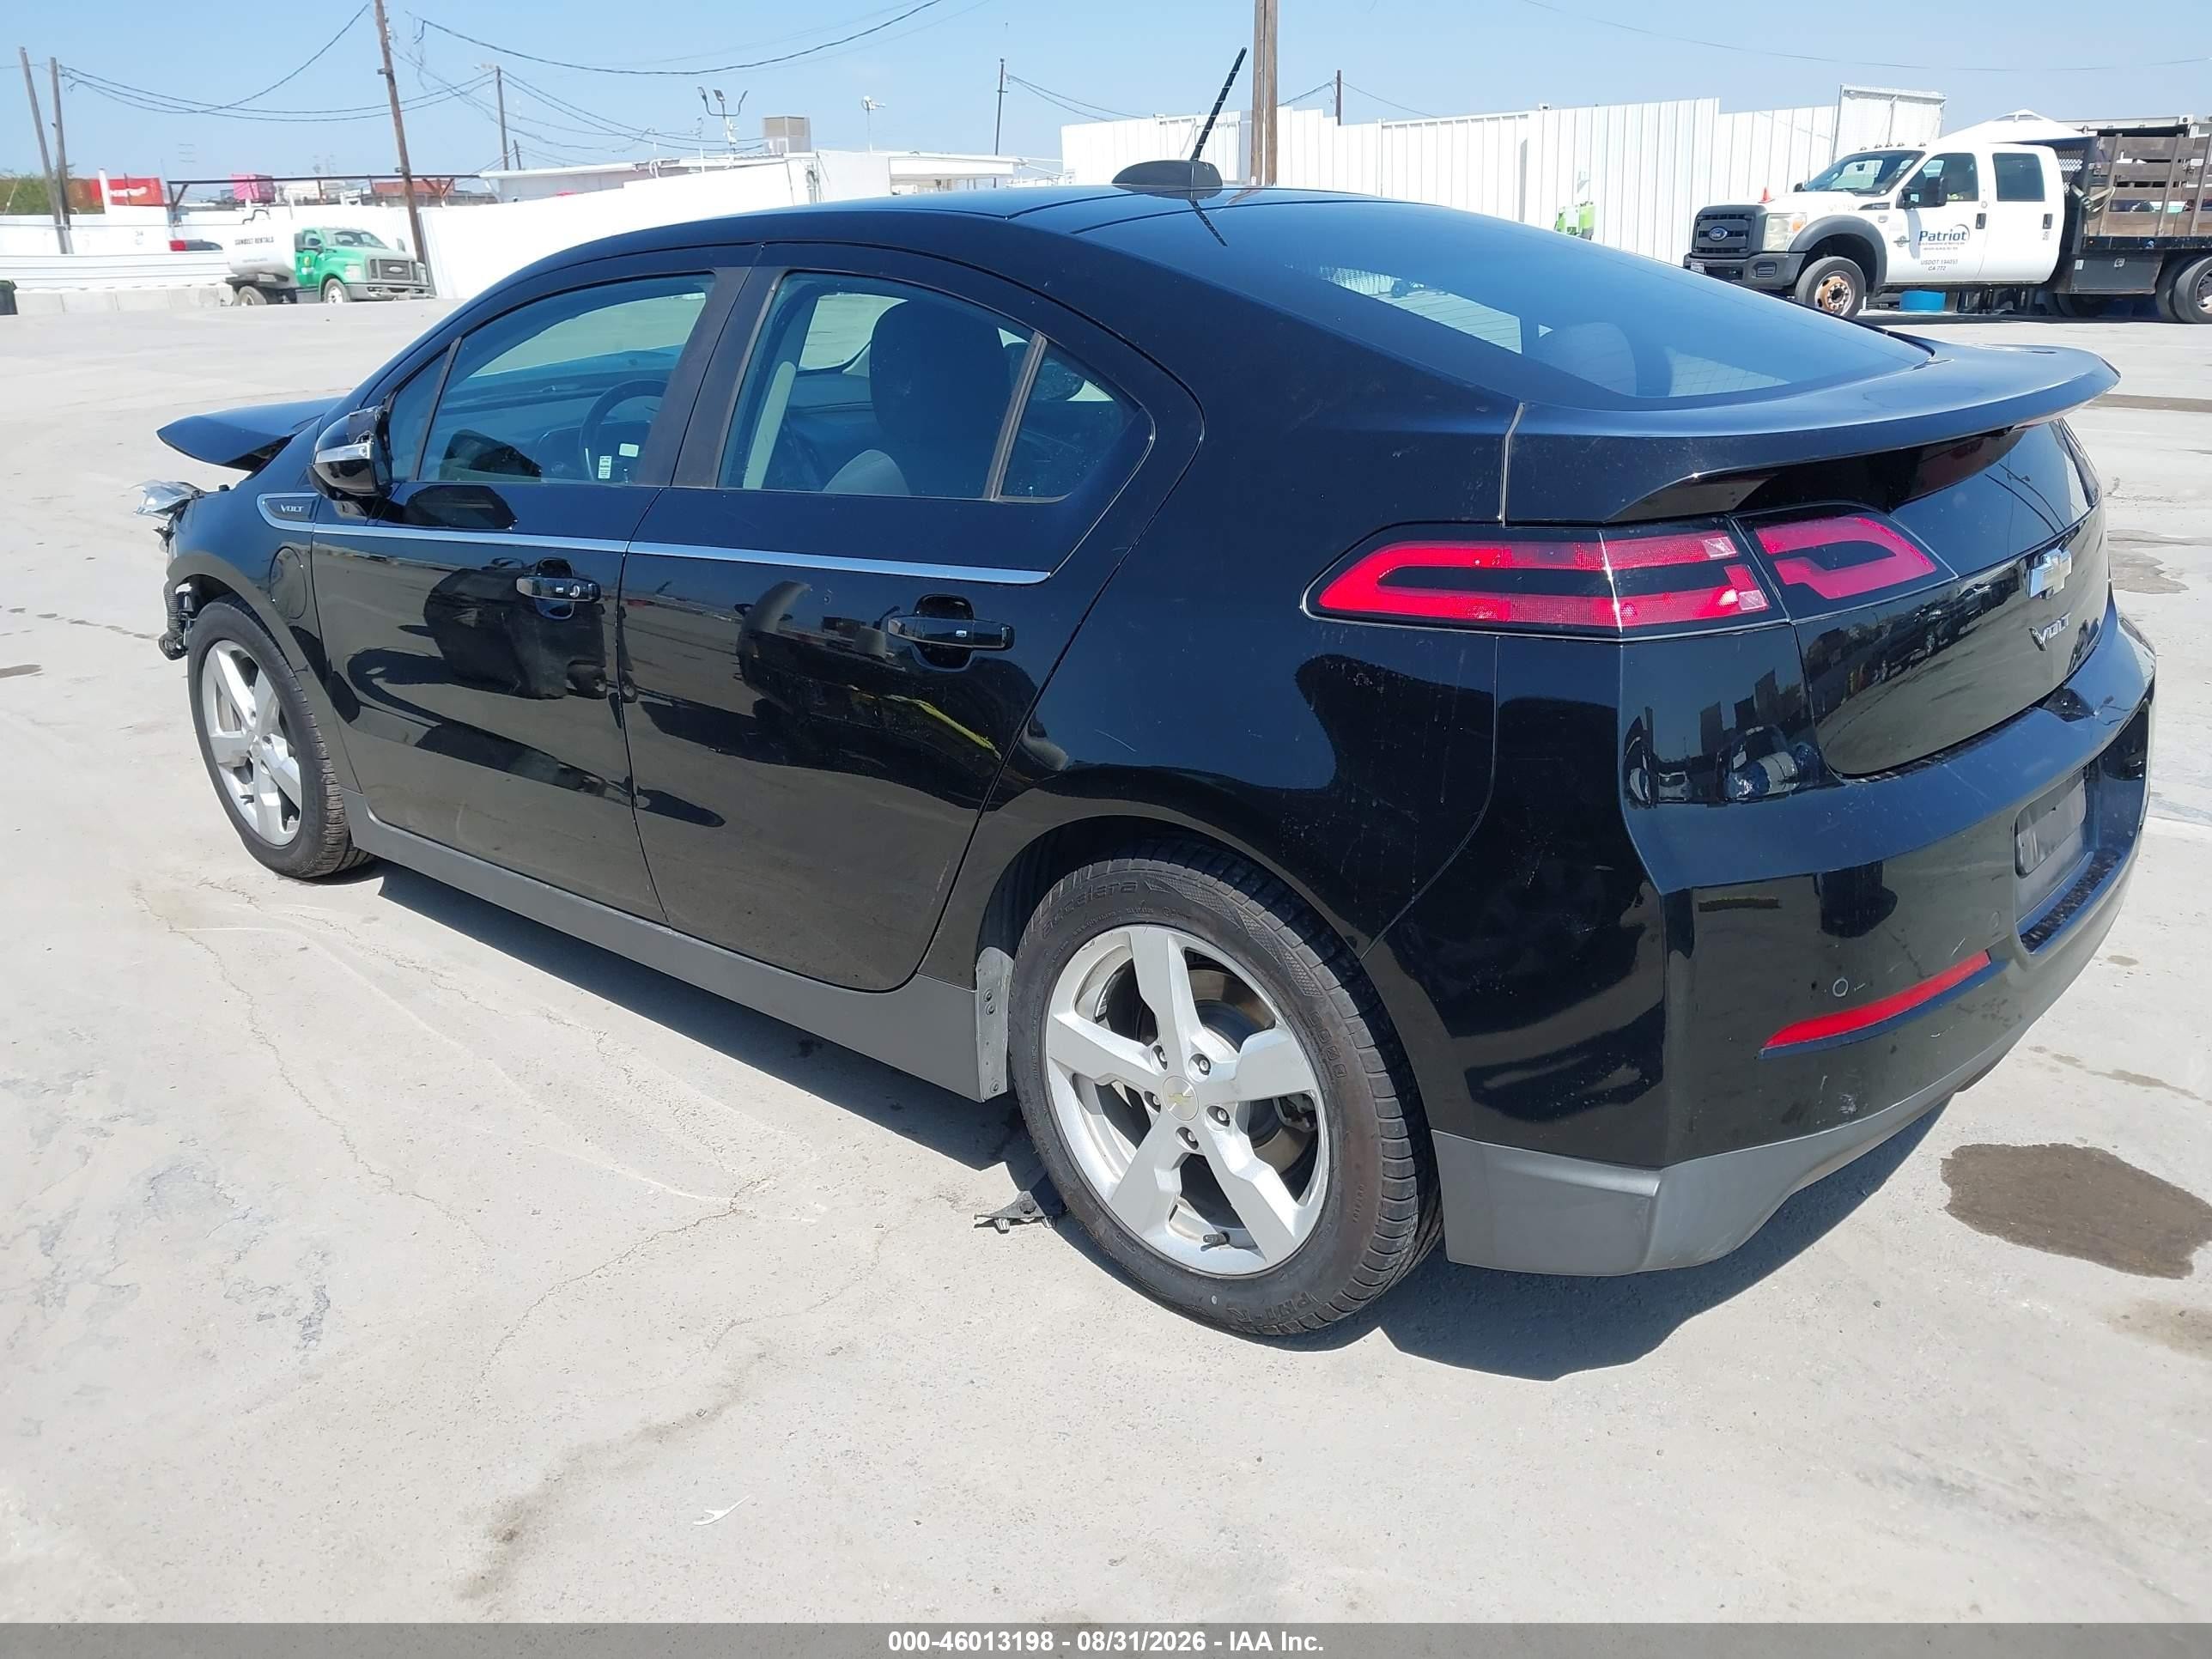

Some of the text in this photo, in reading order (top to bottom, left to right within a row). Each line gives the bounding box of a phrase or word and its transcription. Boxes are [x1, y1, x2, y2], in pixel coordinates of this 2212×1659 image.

[1918, 228, 1966, 241] Patriot
[280, 504, 304, 513] VOLT
[2028, 612, 2072, 651] VOLT
